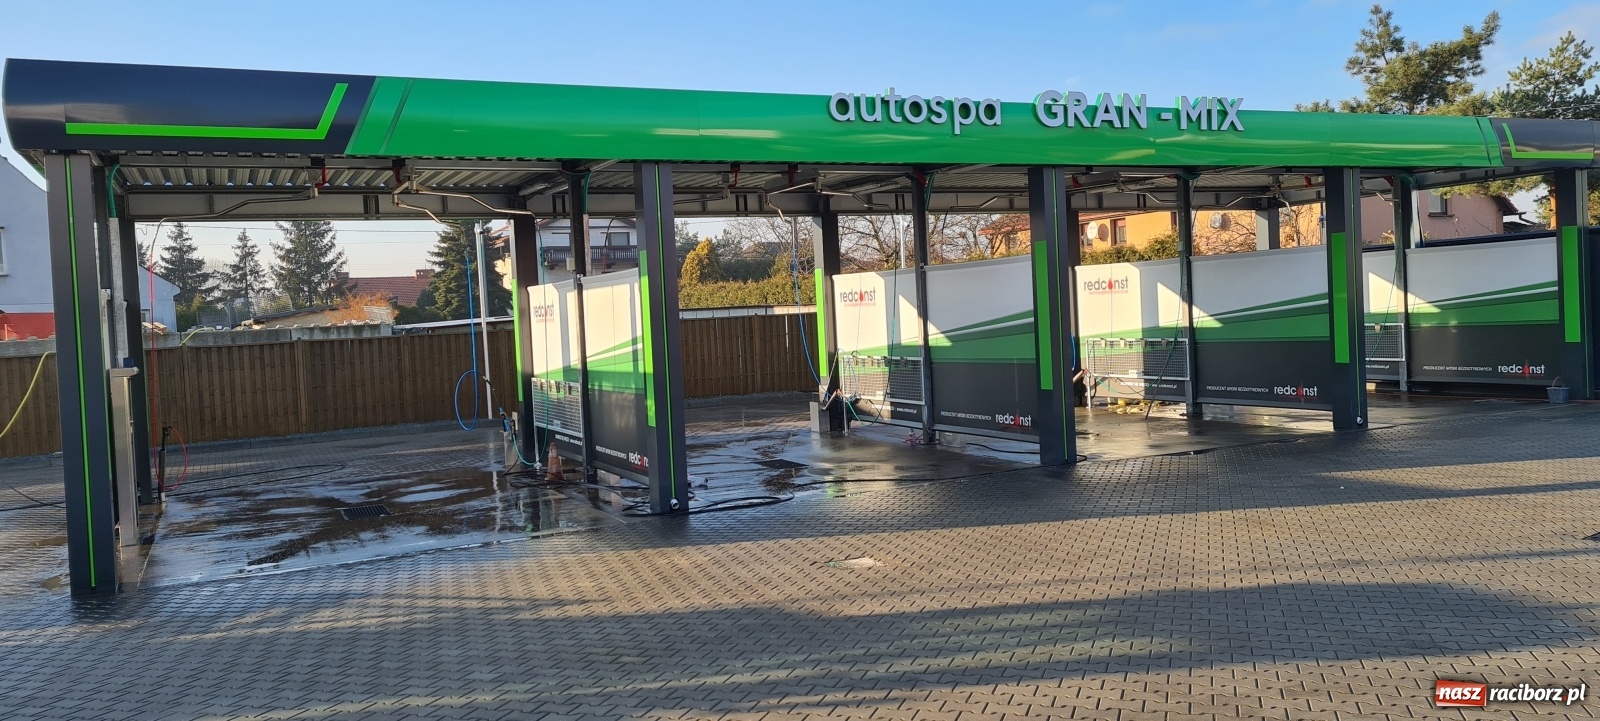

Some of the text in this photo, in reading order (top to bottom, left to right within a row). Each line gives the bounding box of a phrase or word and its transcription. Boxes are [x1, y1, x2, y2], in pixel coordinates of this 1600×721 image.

[827, 87, 1001, 135] autospa
[1035, 90, 1147, 129] GRAN
[1176, 95, 1245, 131] MIX
